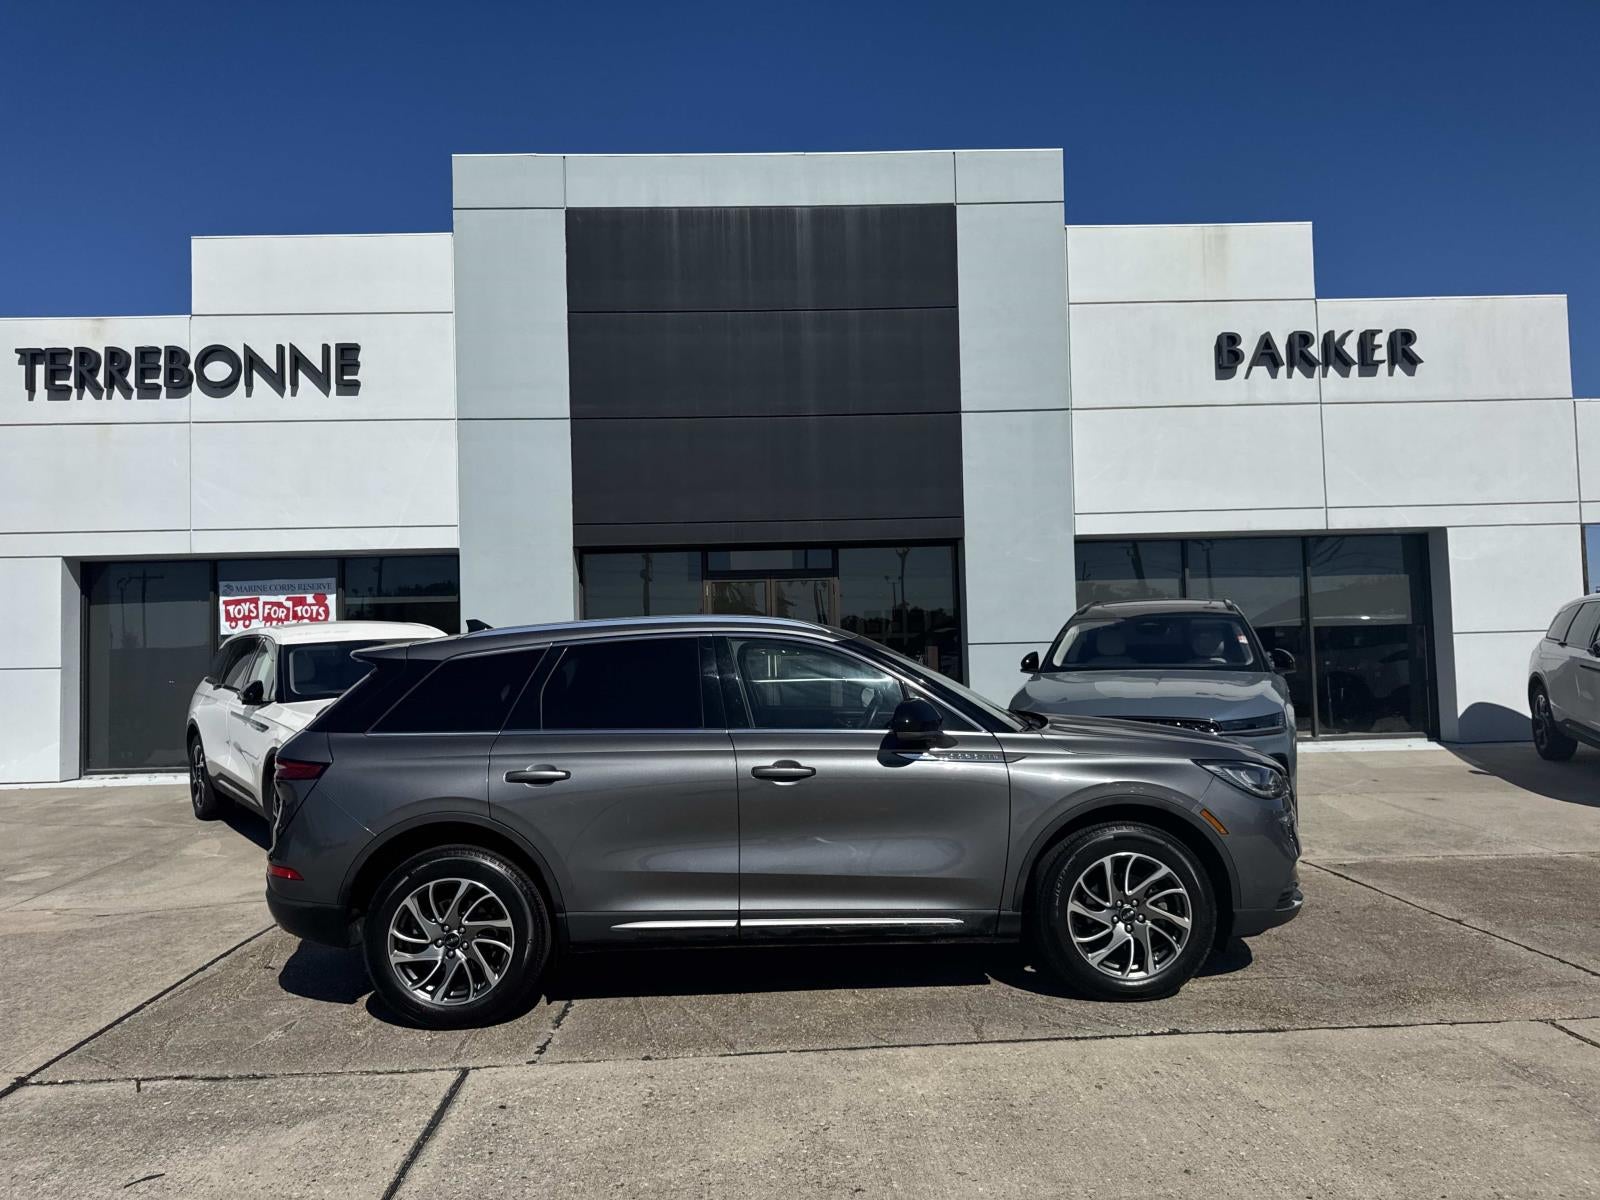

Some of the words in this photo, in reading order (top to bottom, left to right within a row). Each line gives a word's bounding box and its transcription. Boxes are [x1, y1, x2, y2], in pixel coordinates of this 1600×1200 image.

[15, 342, 361, 398] TERREBONNE
[1214, 328, 1425, 378] BARKER
[235, 584, 267, 593] MARINE
[269, 583, 297, 592] CORPS
[297, 582, 332, 591] RESERVE
[226, 602, 257, 618] TOYS
[263, 605, 287, 620] FOR
[293, 605, 325, 620] TOTS
